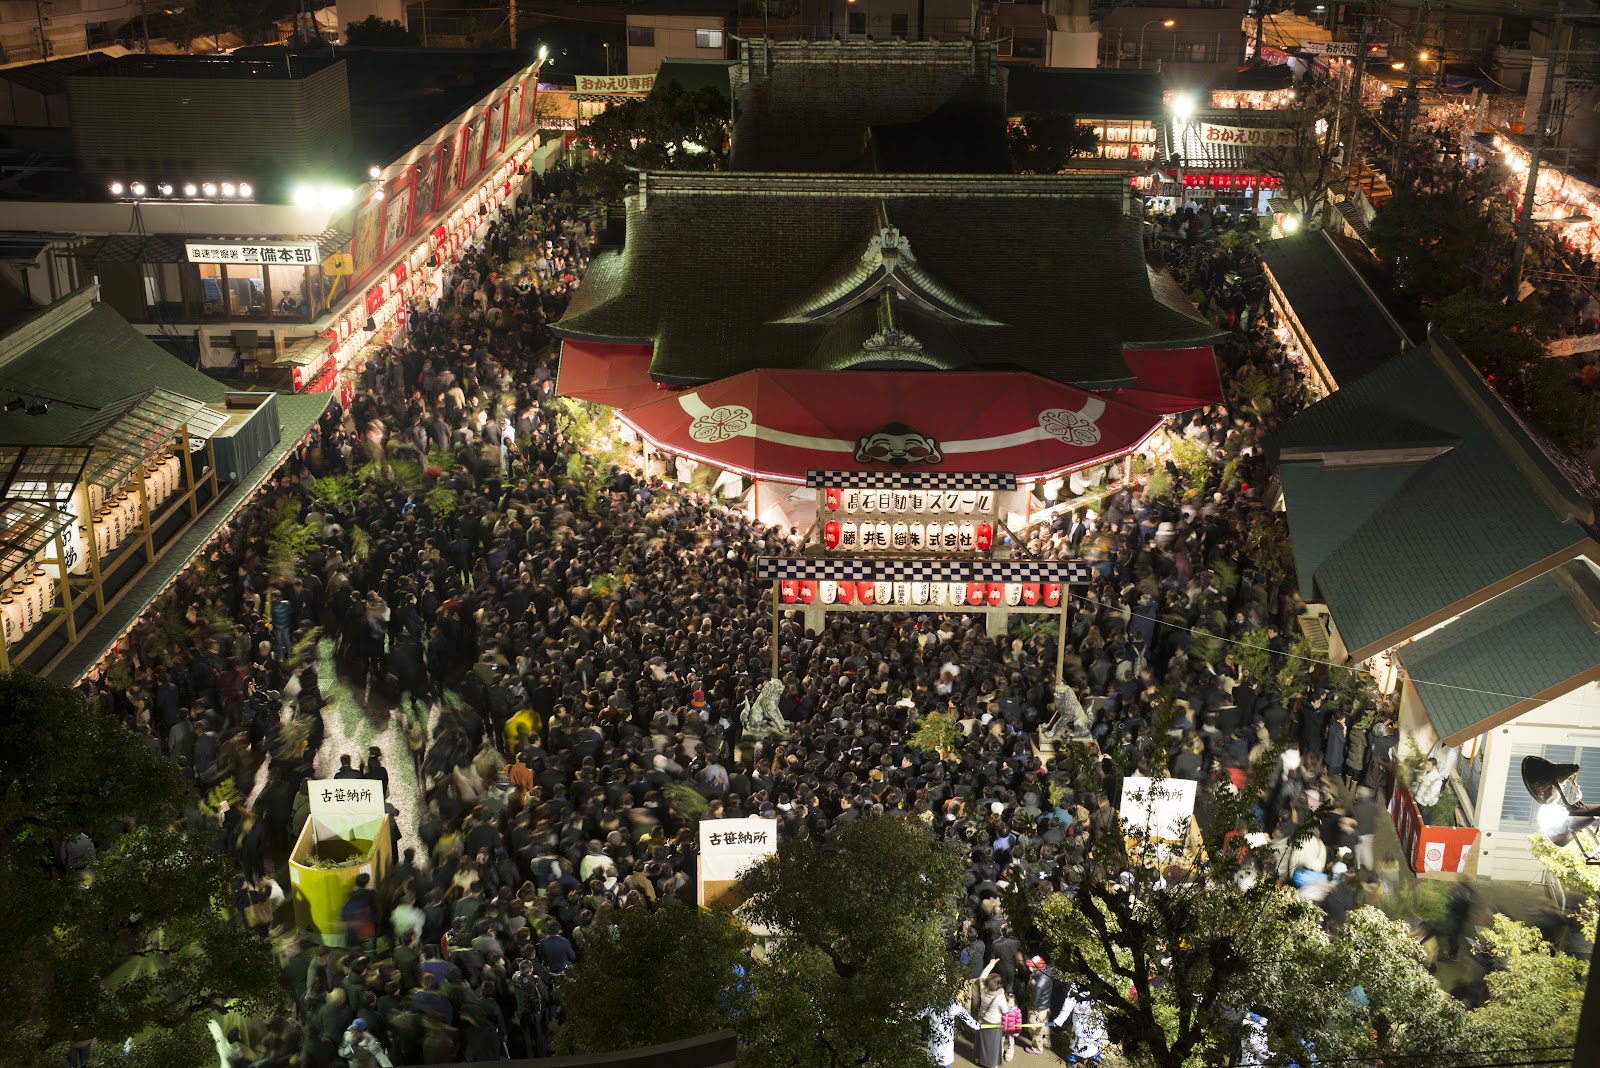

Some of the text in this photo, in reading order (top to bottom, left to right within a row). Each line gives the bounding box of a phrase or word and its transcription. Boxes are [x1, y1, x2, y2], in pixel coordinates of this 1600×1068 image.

[241, 247, 312, 263] 警備本部
[321, 788, 372, 803] 古笹納所
[709, 831, 768, 846] 古笹納所
